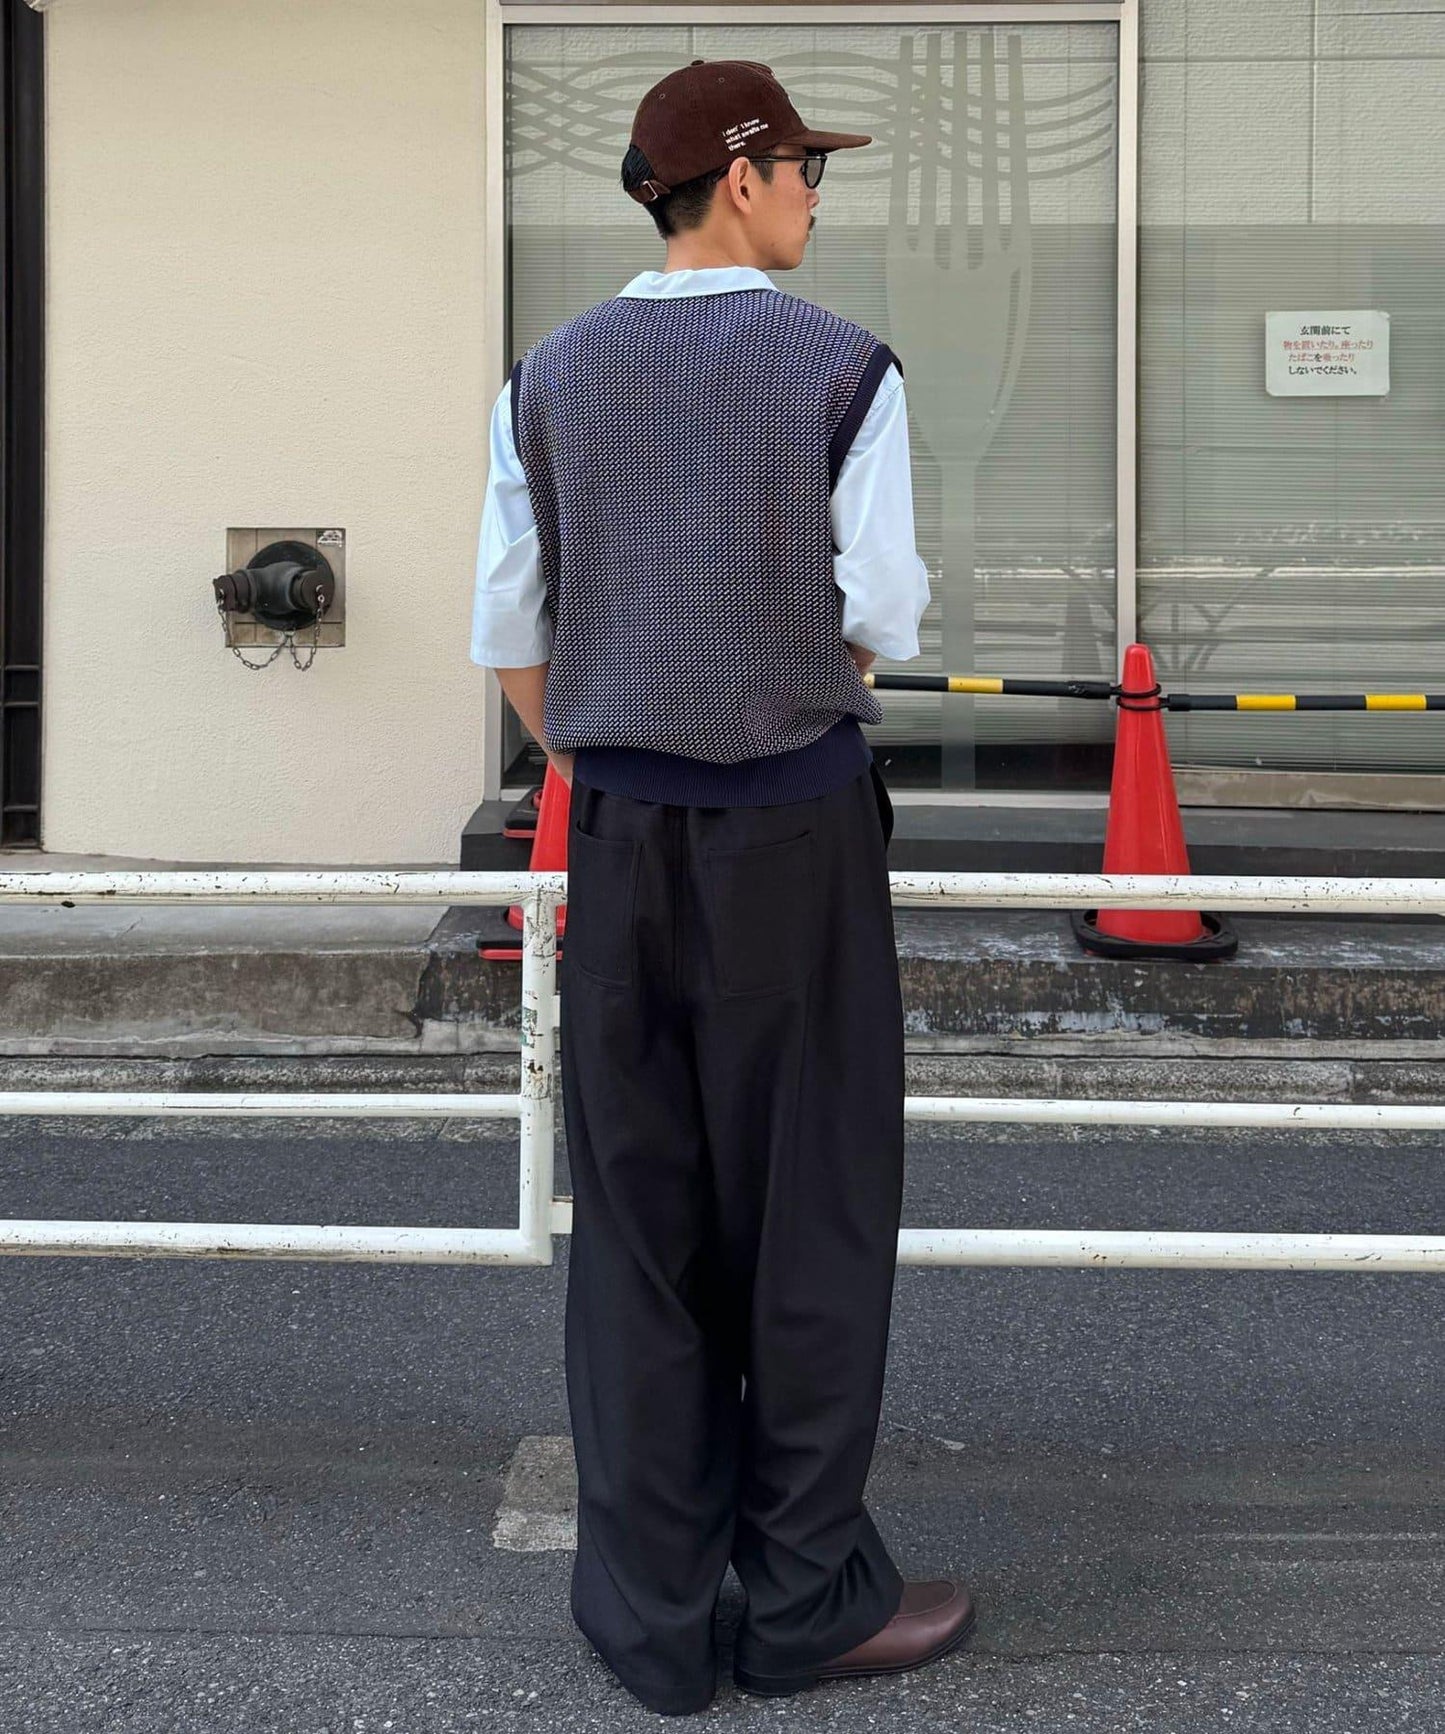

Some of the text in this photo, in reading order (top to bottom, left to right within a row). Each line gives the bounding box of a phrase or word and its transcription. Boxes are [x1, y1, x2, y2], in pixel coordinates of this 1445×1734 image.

[744, 118, 759, 127] know
[725, 133, 741, 144] what
[741, 127, 760, 137] awaits
[728, 141, 746, 151] there.
[1300, 325, 1351, 336] 玄関前にて
[1288, 365, 1357, 375] しないでください。
